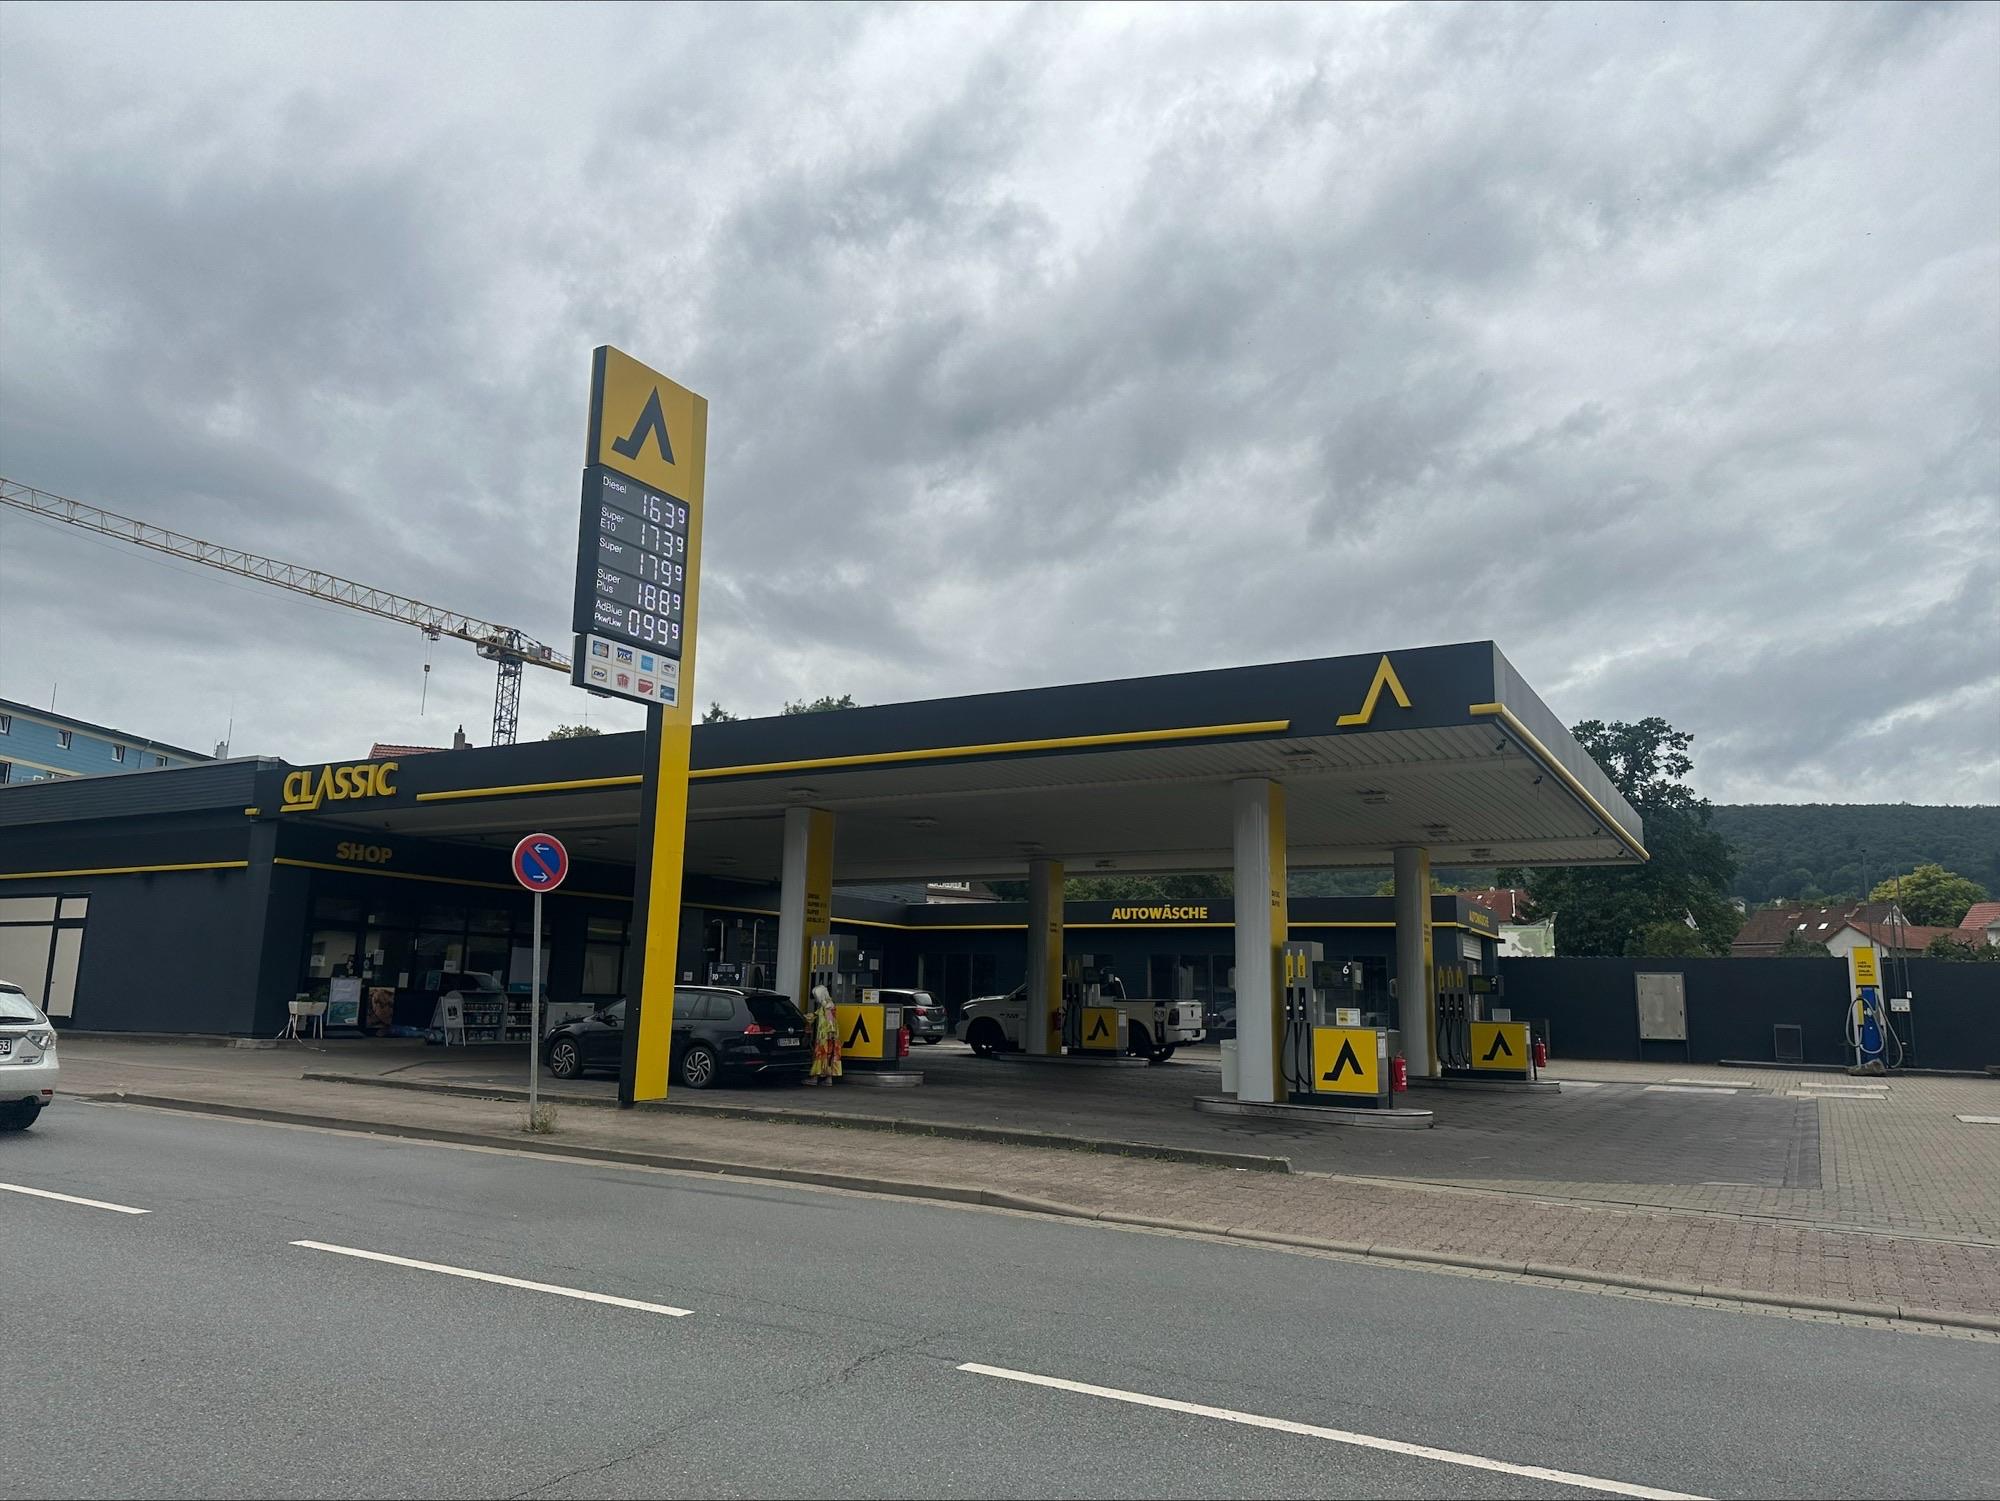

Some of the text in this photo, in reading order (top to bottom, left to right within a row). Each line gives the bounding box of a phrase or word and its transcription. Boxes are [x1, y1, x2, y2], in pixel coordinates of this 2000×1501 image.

[602, 476, 627, 494] Diesel
[601, 506, 625, 523] Super
[600, 517, 616, 532] E10
[599, 537, 623, 554] Super
[597, 568, 621, 584] Super
[596, 579, 614, 593] Plus
[595, 600, 623, 617] AdBlue
[616, 652, 633, 663] VISA
[279, 761, 399, 813] CLASSIC
[336, 841, 393, 864] SHOP
[1111, 904, 1208, 920] AUTOWÄSCHE
[1342, 965, 1349, 975] 6
[1490, 977, 1496, 985] 2
